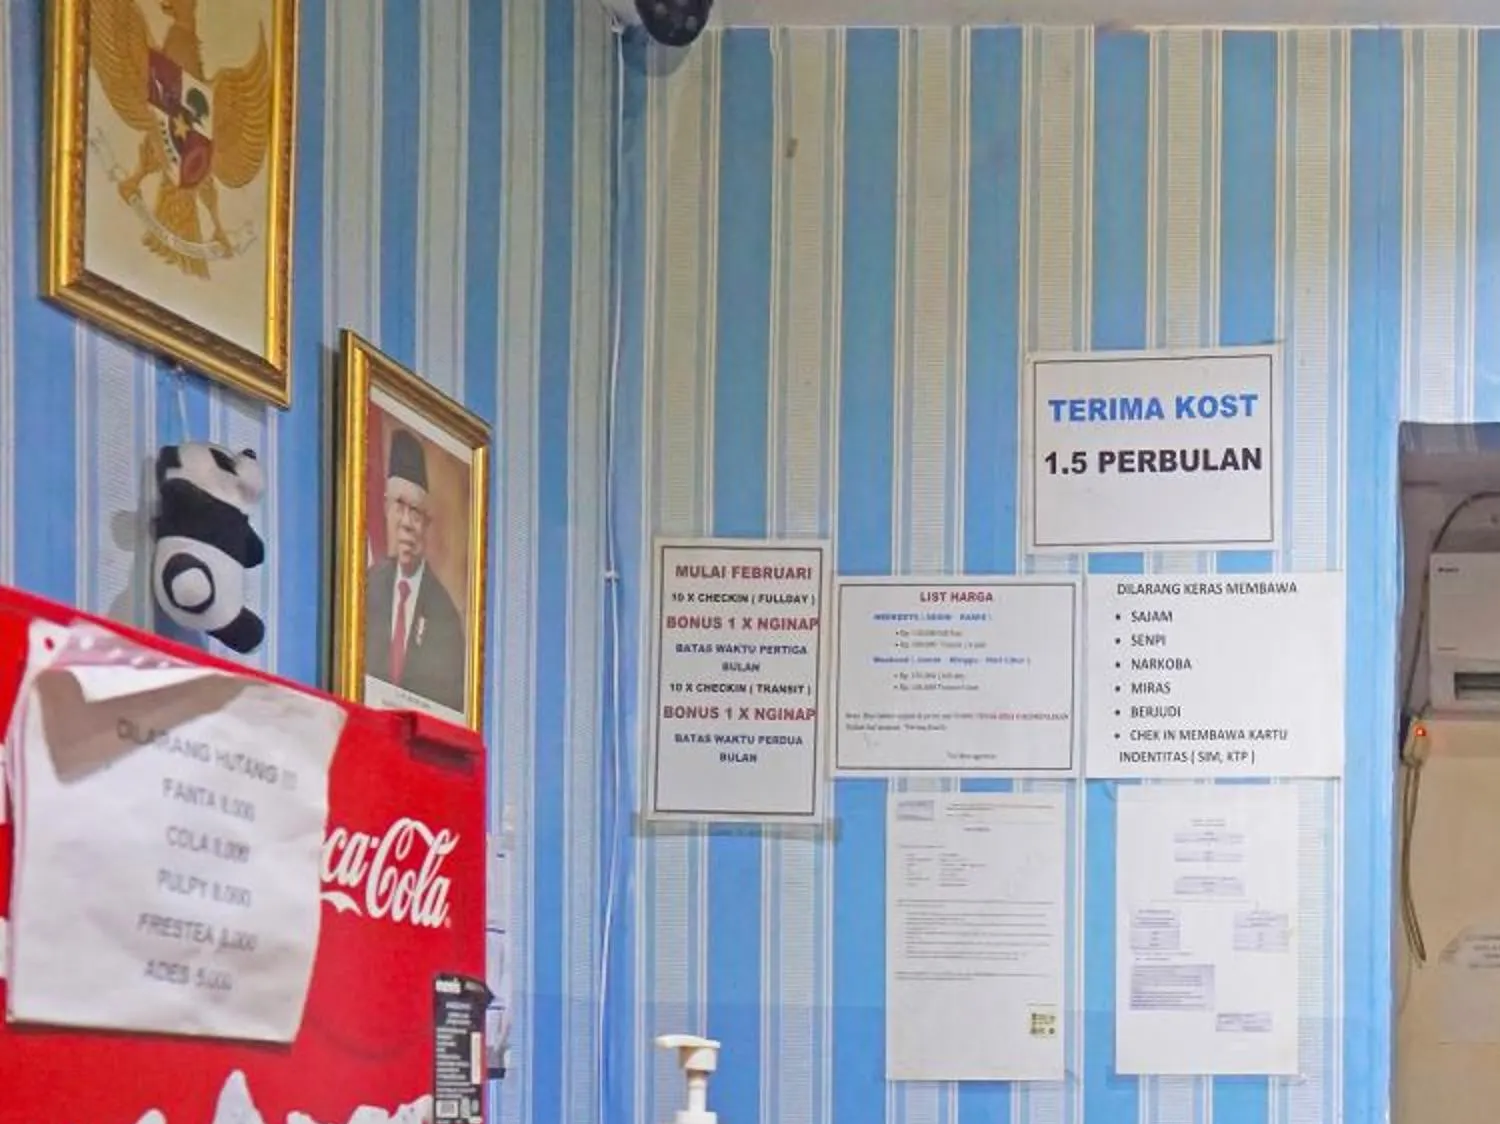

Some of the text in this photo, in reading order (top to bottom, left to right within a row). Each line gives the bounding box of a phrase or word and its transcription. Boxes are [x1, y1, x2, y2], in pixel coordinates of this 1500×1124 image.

[1048, 394, 1258, 422] TERIMA KOST
[1045, 447, 1262, 474] 1.5 PERBULAN
[675, 565, 812, 580] MULAI FEBRUARI
[1117, 582, 1298, 596] DILARANG KERAS MEMBAWA
[672, 592, 684, 602] 10
[697, 593, 749, 603] CHECKIN
[919, 592, 993, 602] LIST HARGA
[1131, 611, 1173, 623] SAJAM
[666, 616, 819, 631] BONUS 1 X NGINAP
[1131, 634, 1166, 646] SENPI
[675, 643, 808, 655] BATAS WAKTU PERTIGA
[722, 662, 760, 671] BULAN
[1131, 658, 1192, 670] NARKOBA
[670, 683, 683, 692] 10
[696, 684, 747, 693] CHECKIN
[757, 684, 805, 694] TRANSIT
[1131, 682, 1171, 694] MIRAS
[663, 706, 817, 721] BONUS 1 X NGINAP
[1131, 706, 1181, 718] BERJUDI
[674, 734, 803, 745] BATAS WAKTU PERDUA
[1130, 730, 1288, 741] CHEK IN MEMBAWA KARTU
[719, 753, 757, 763] BULAN
[1119, 751, 1187, 763] INDENTITAS
[1227, 751, 1249, 763] KTP
[163, 778, 216, 807] FANTA
[166, 826, 209, 852] COLA
[320, 817, 460, 928] ca-Cola
